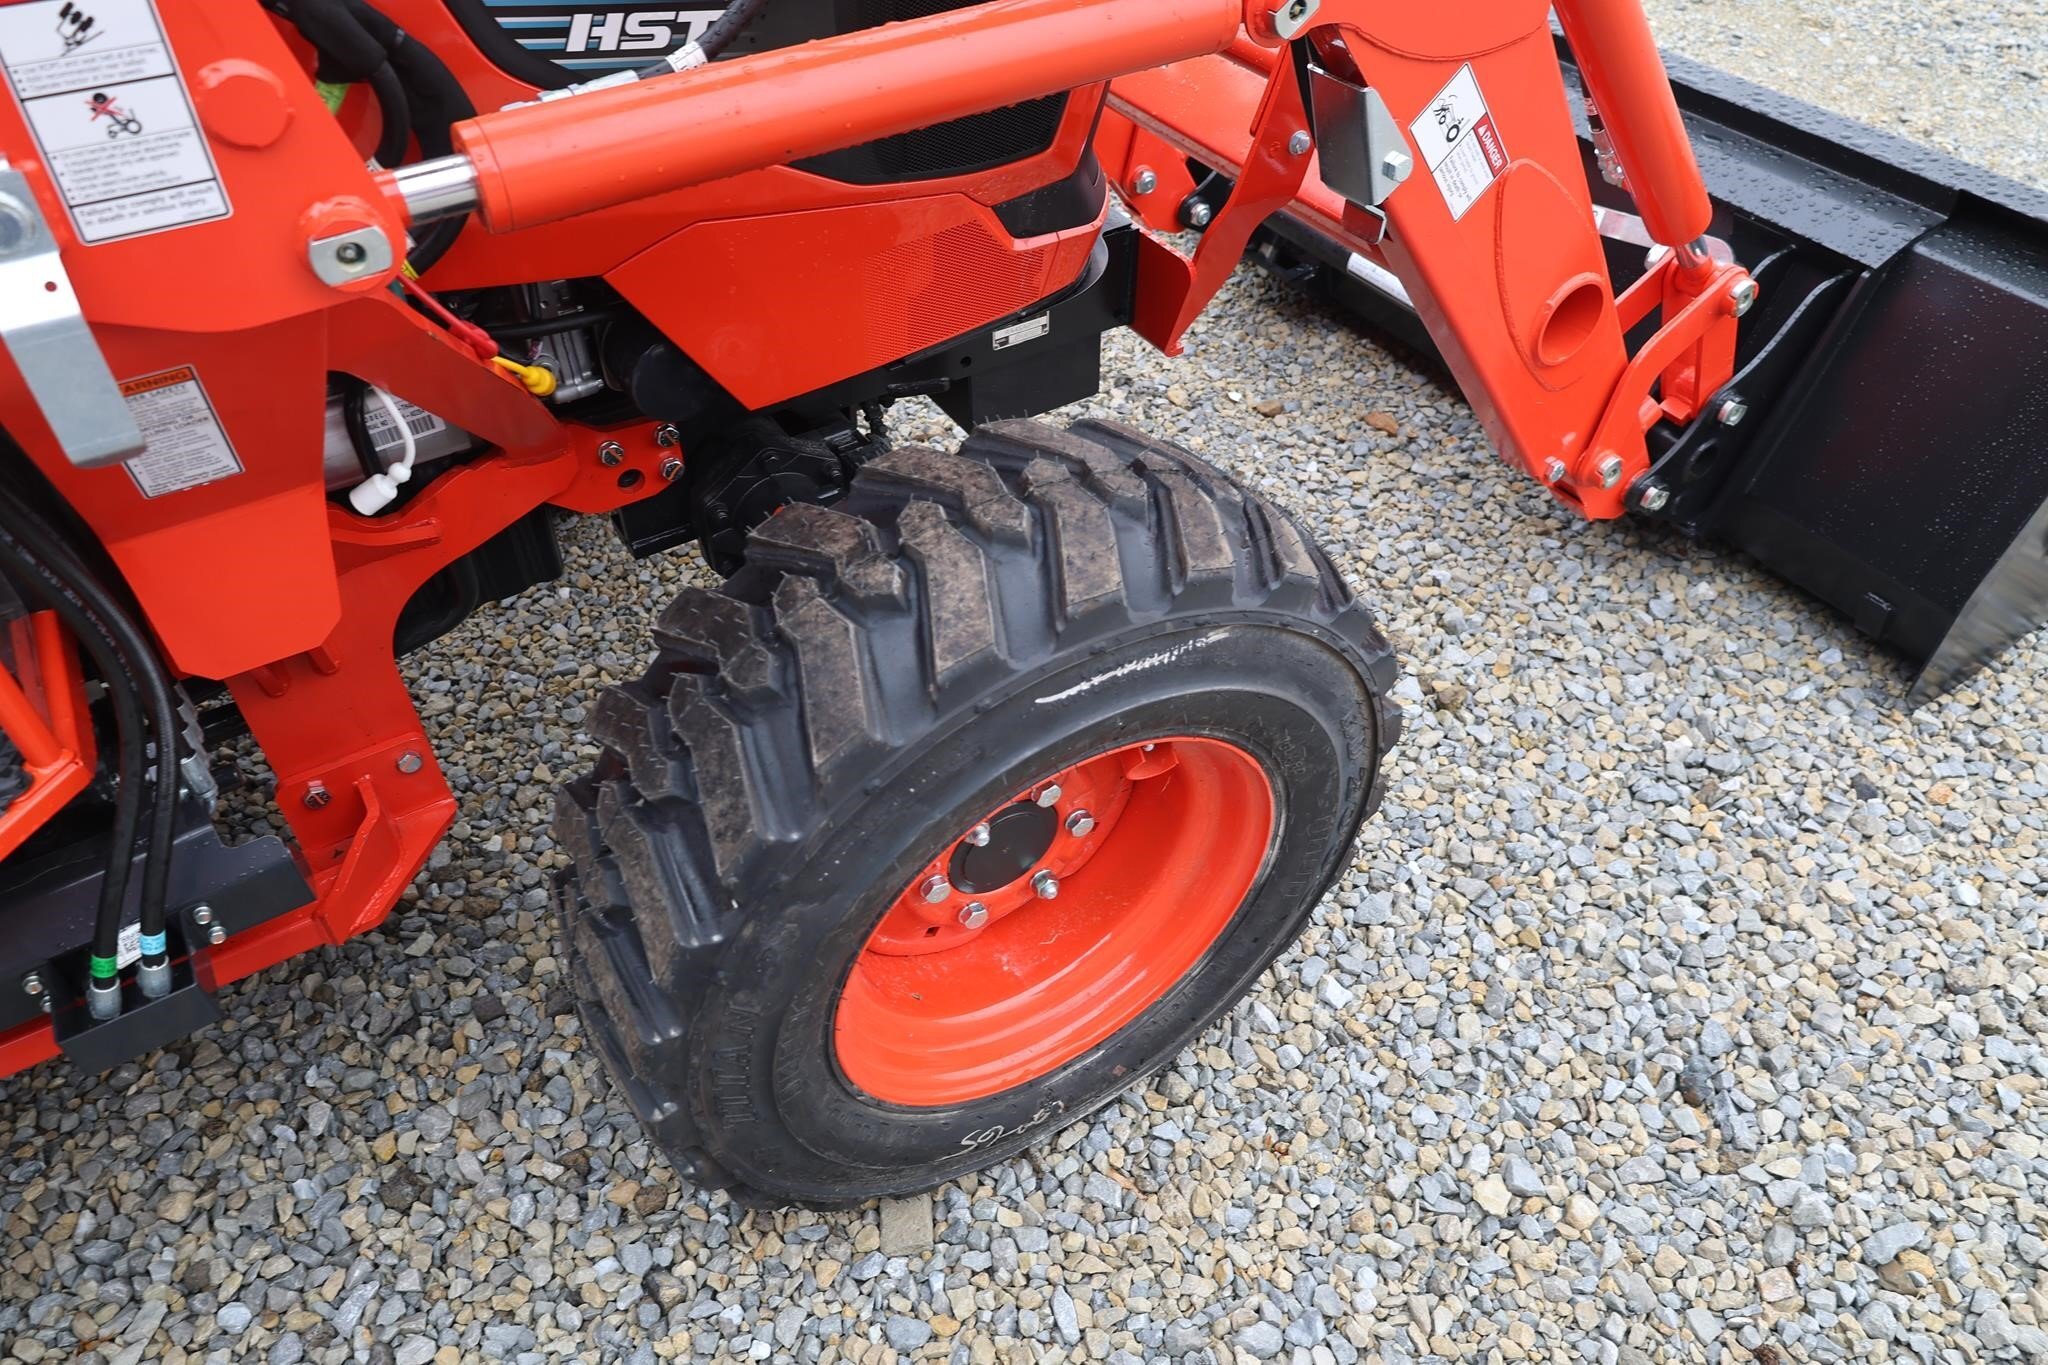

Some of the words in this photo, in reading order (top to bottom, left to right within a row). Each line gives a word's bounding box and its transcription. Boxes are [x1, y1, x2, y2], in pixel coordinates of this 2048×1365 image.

[566, 10, 728, 52] HST
[1481, 132, 1503, 170] DANGER
[124, 371, 189, 393] ARNING
